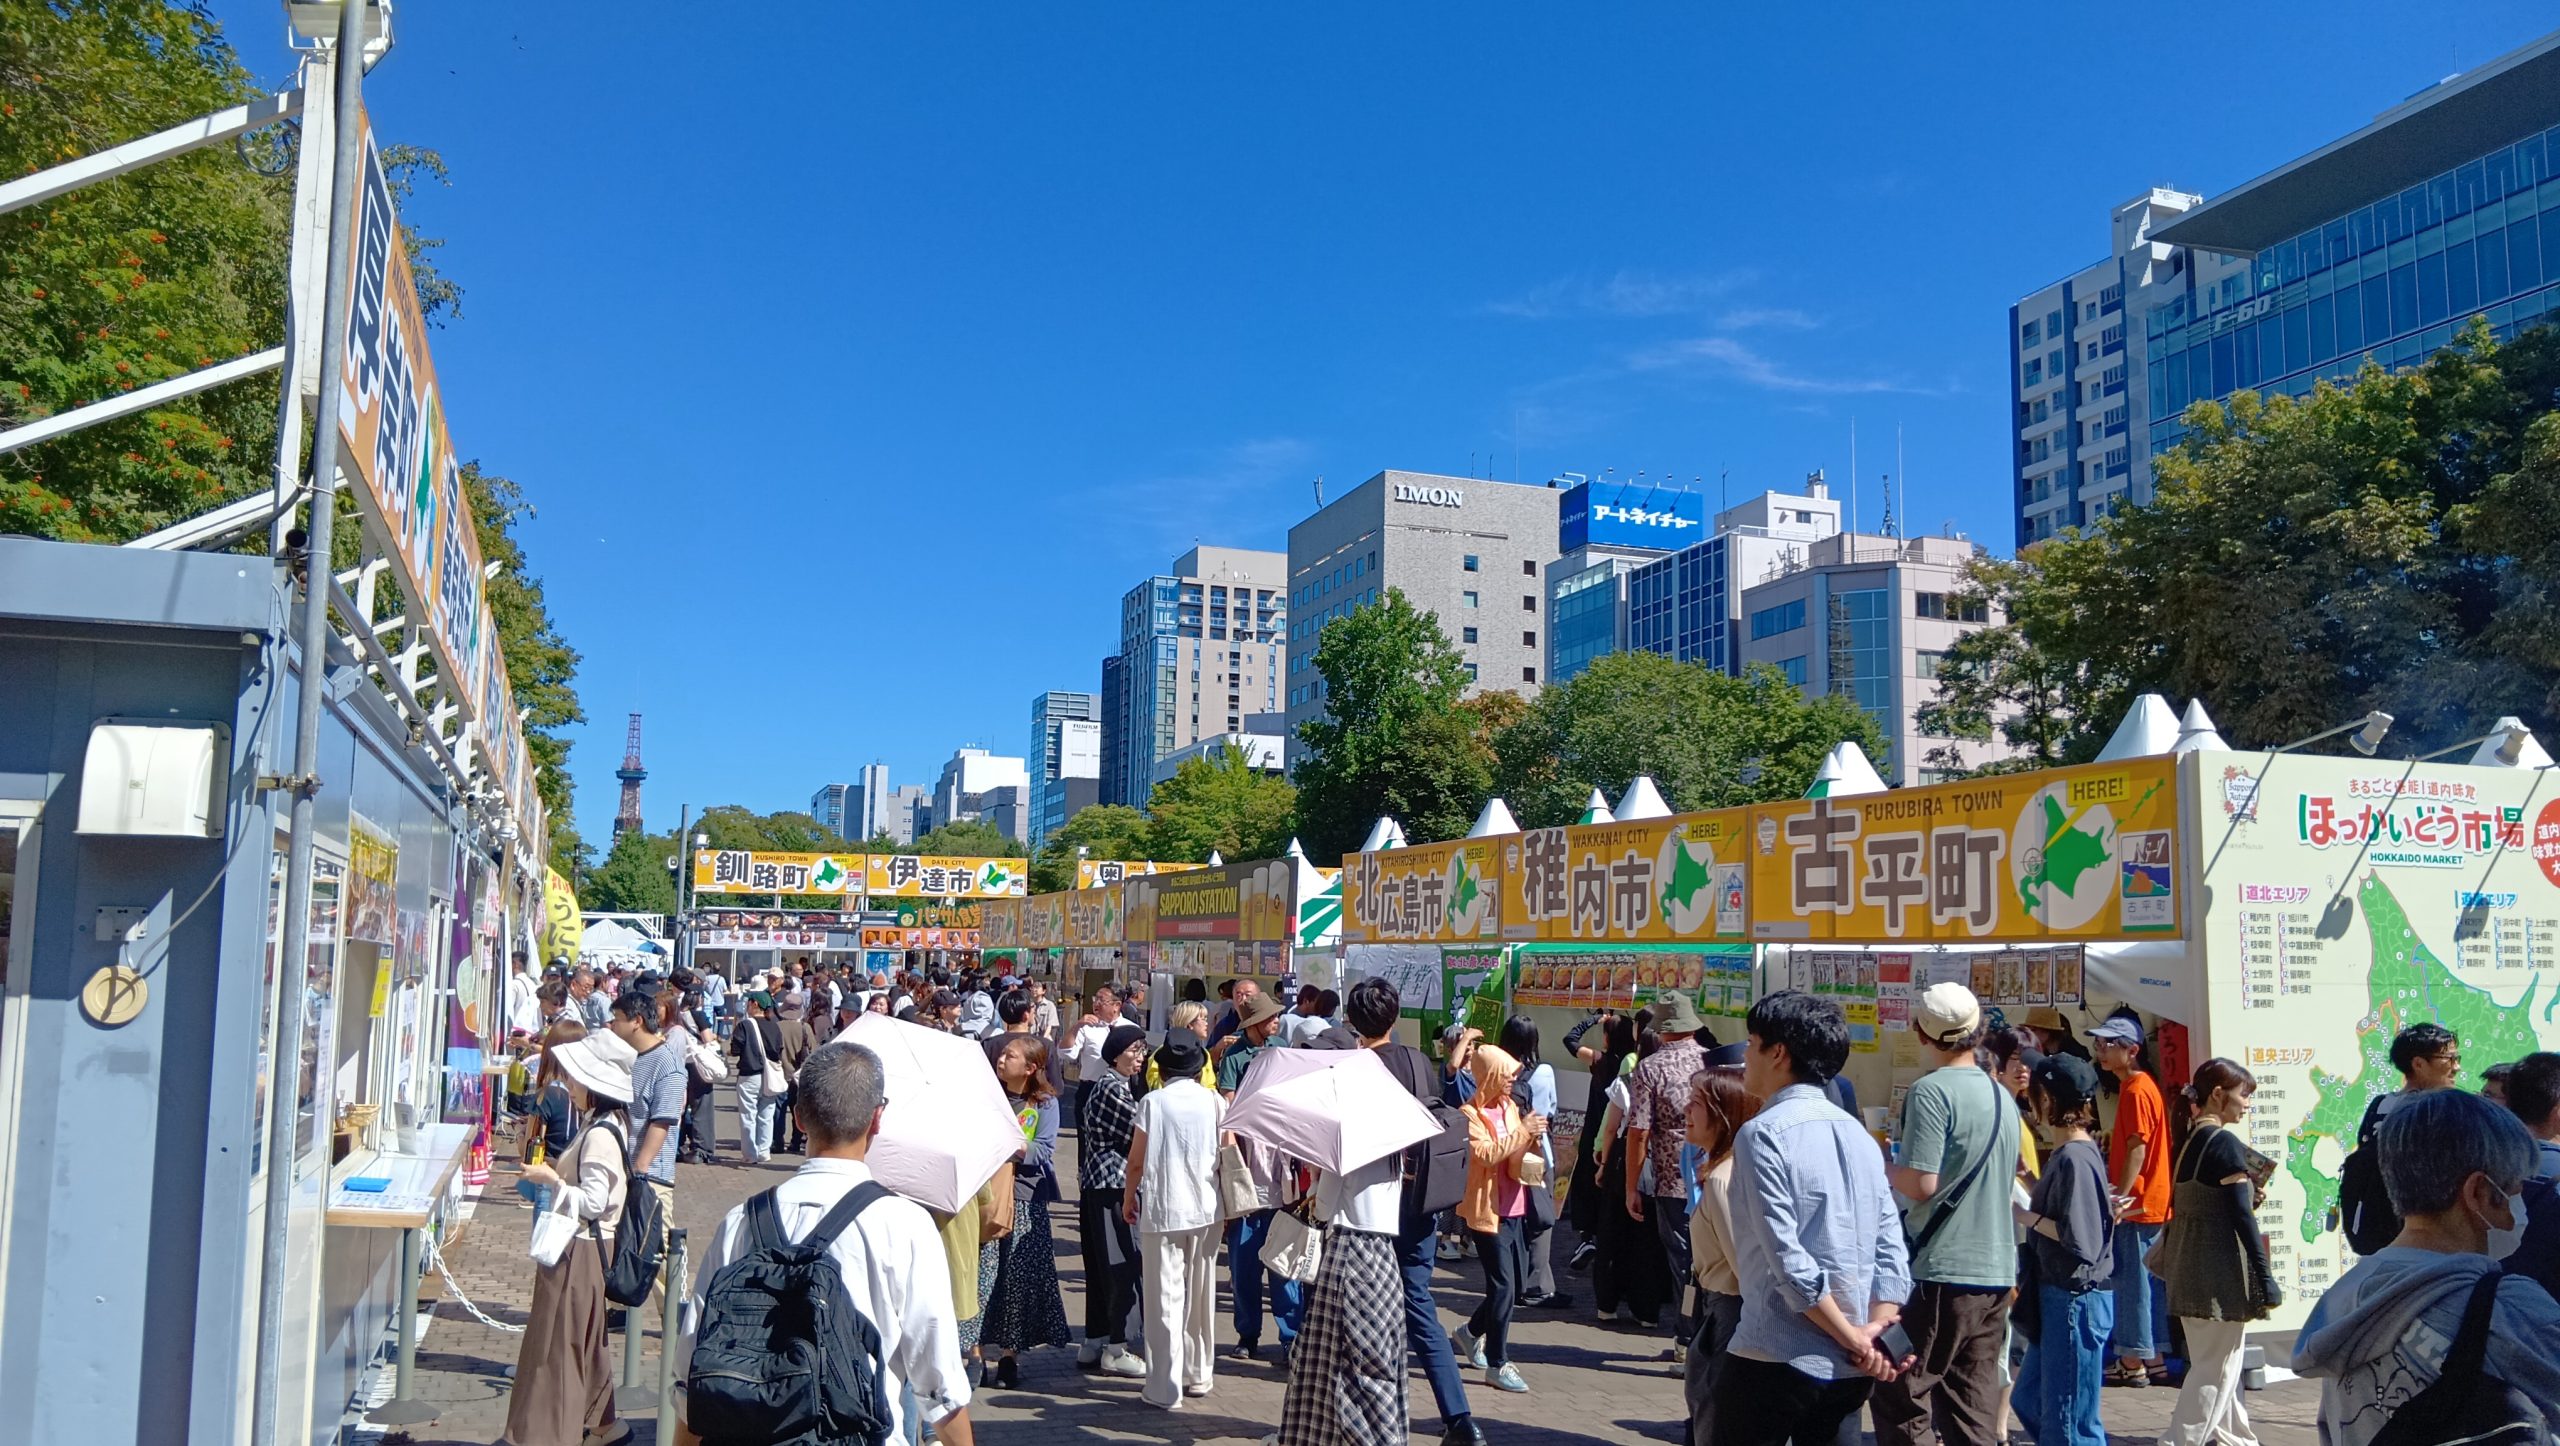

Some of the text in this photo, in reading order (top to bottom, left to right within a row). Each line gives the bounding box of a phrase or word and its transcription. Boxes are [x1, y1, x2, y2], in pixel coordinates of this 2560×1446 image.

[2214, 294, 2272, 332] F-60
[350, 133, 417, 546] 厚岸町
[1396, 485, 1464, 506] IMON
[1594, 505, 1698, 528] アートネイチャー
[2073, 777, 2123, 801] HERE!
[1864, 789, 2003, 822] FURUBIRA TOWN
[1691, 823, 1719, 839] HERE!
[2299, 793, 2524, 851] ほっかいどう市場
[1466, 848, 1485, 859] HERE!
[1573, 829, 1649, 848] WAKKANAI CITY
[716, 852, 808, 890] 釧路町
[1381, 851, 1445, 868] KITAHIROSHIMA CITY
[1788, 800, 1999, 929] 古平町
[2370, 852, 2463, 864] HOKKAIDO MARKET
[887, 856, 973, 893] 伊達市
[1525, 831, 1651, 931] 稚内市
[1160, 887, 1237, 917] SAPPORO STATION
[1356, 854, 1444, 934] 北広島市
[2247, 885, 2309, 902] 道北エリア
[1071, 891, 1100, 943] 今金町
[2253, 1048, 2314, 1064] 道央エリア
